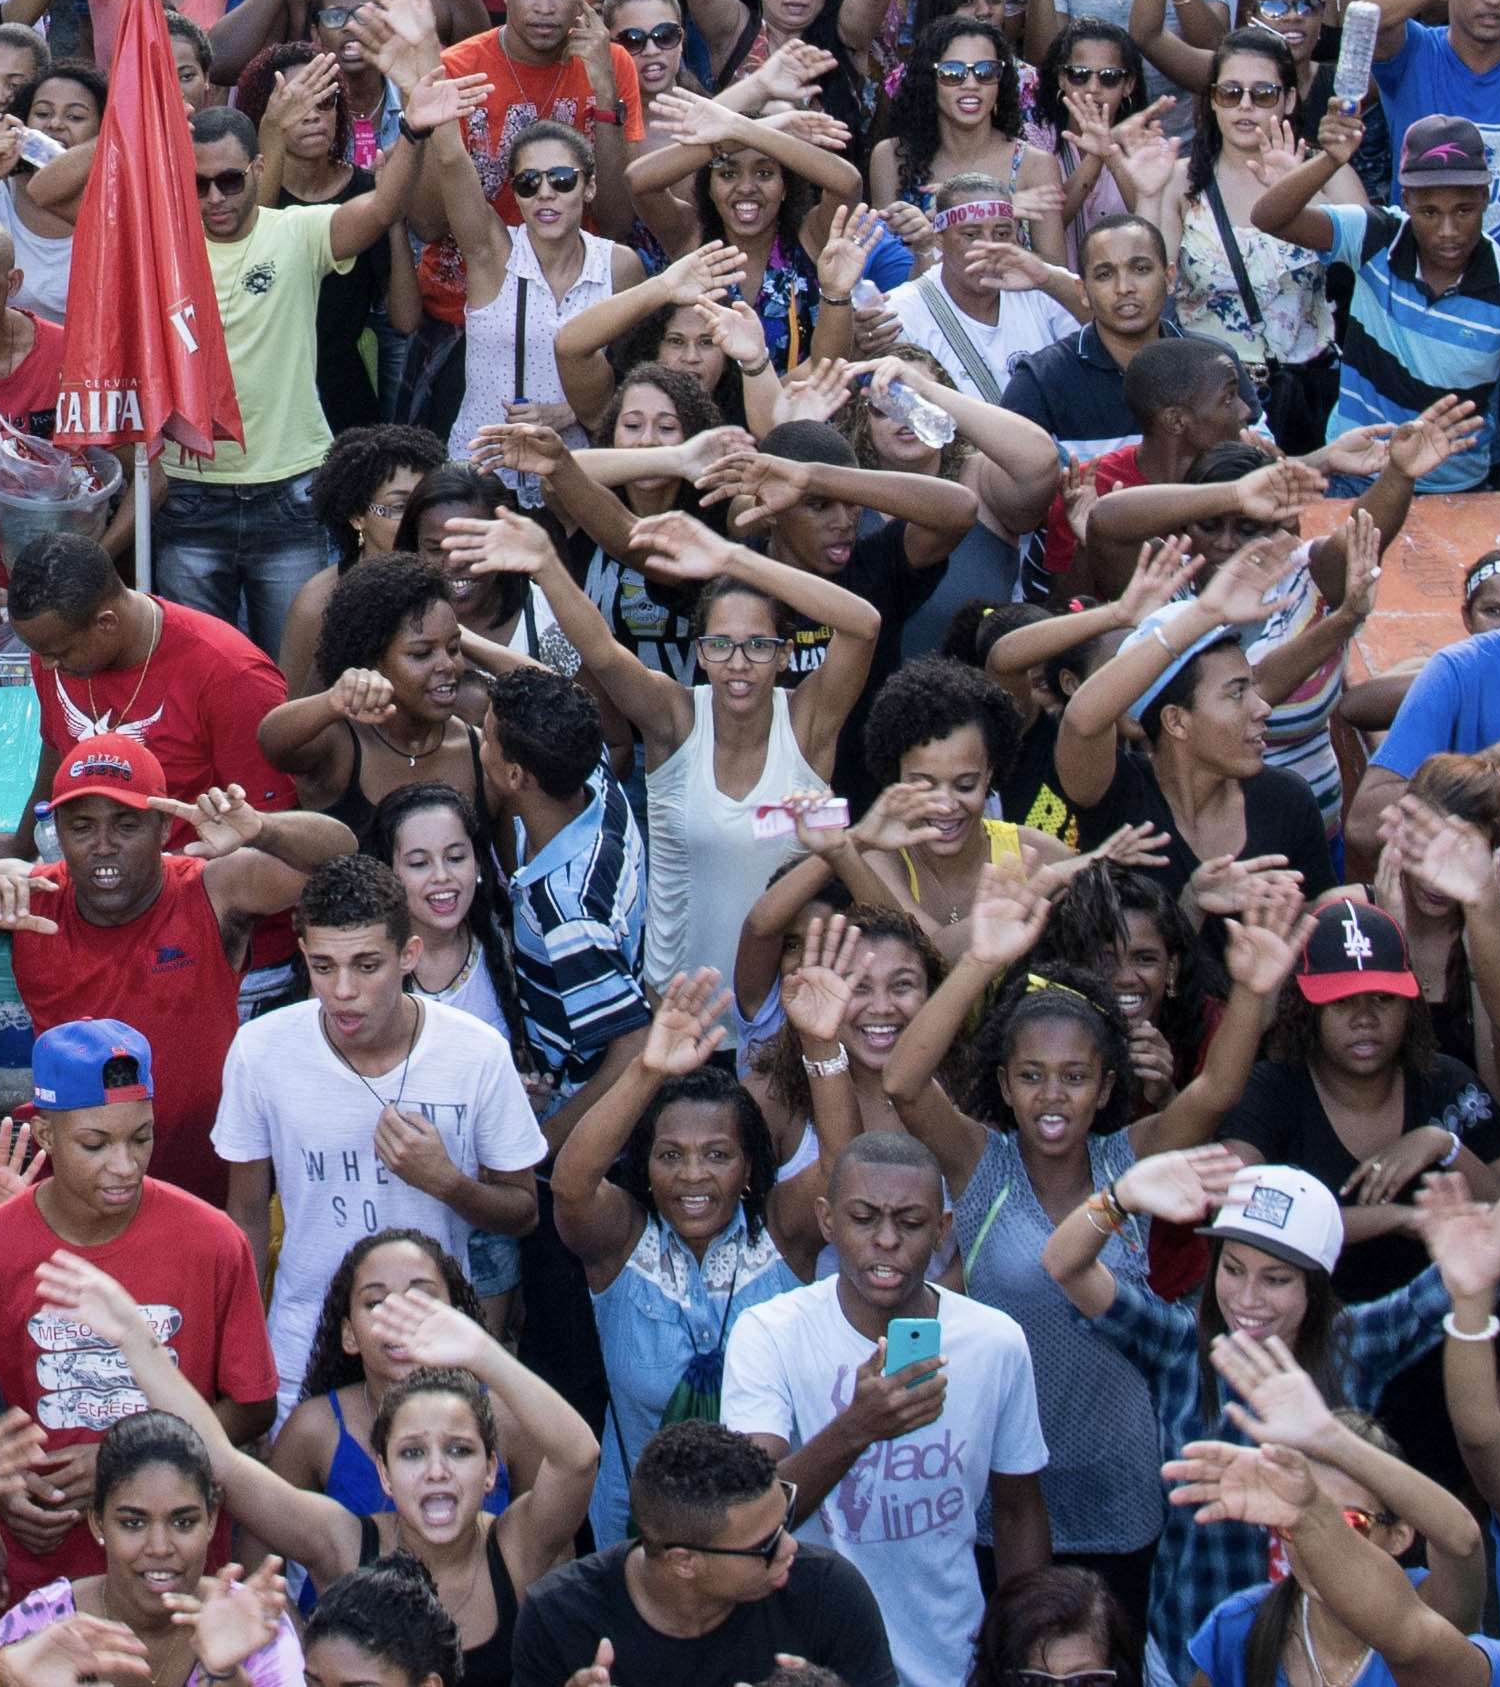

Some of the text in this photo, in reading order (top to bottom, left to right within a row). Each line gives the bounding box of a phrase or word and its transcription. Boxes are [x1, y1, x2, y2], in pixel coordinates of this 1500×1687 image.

[1340, 919, 1374, 958] LA
[331, 1194, 378, 1235] SO
[881, 1479, 967, 1539] line
